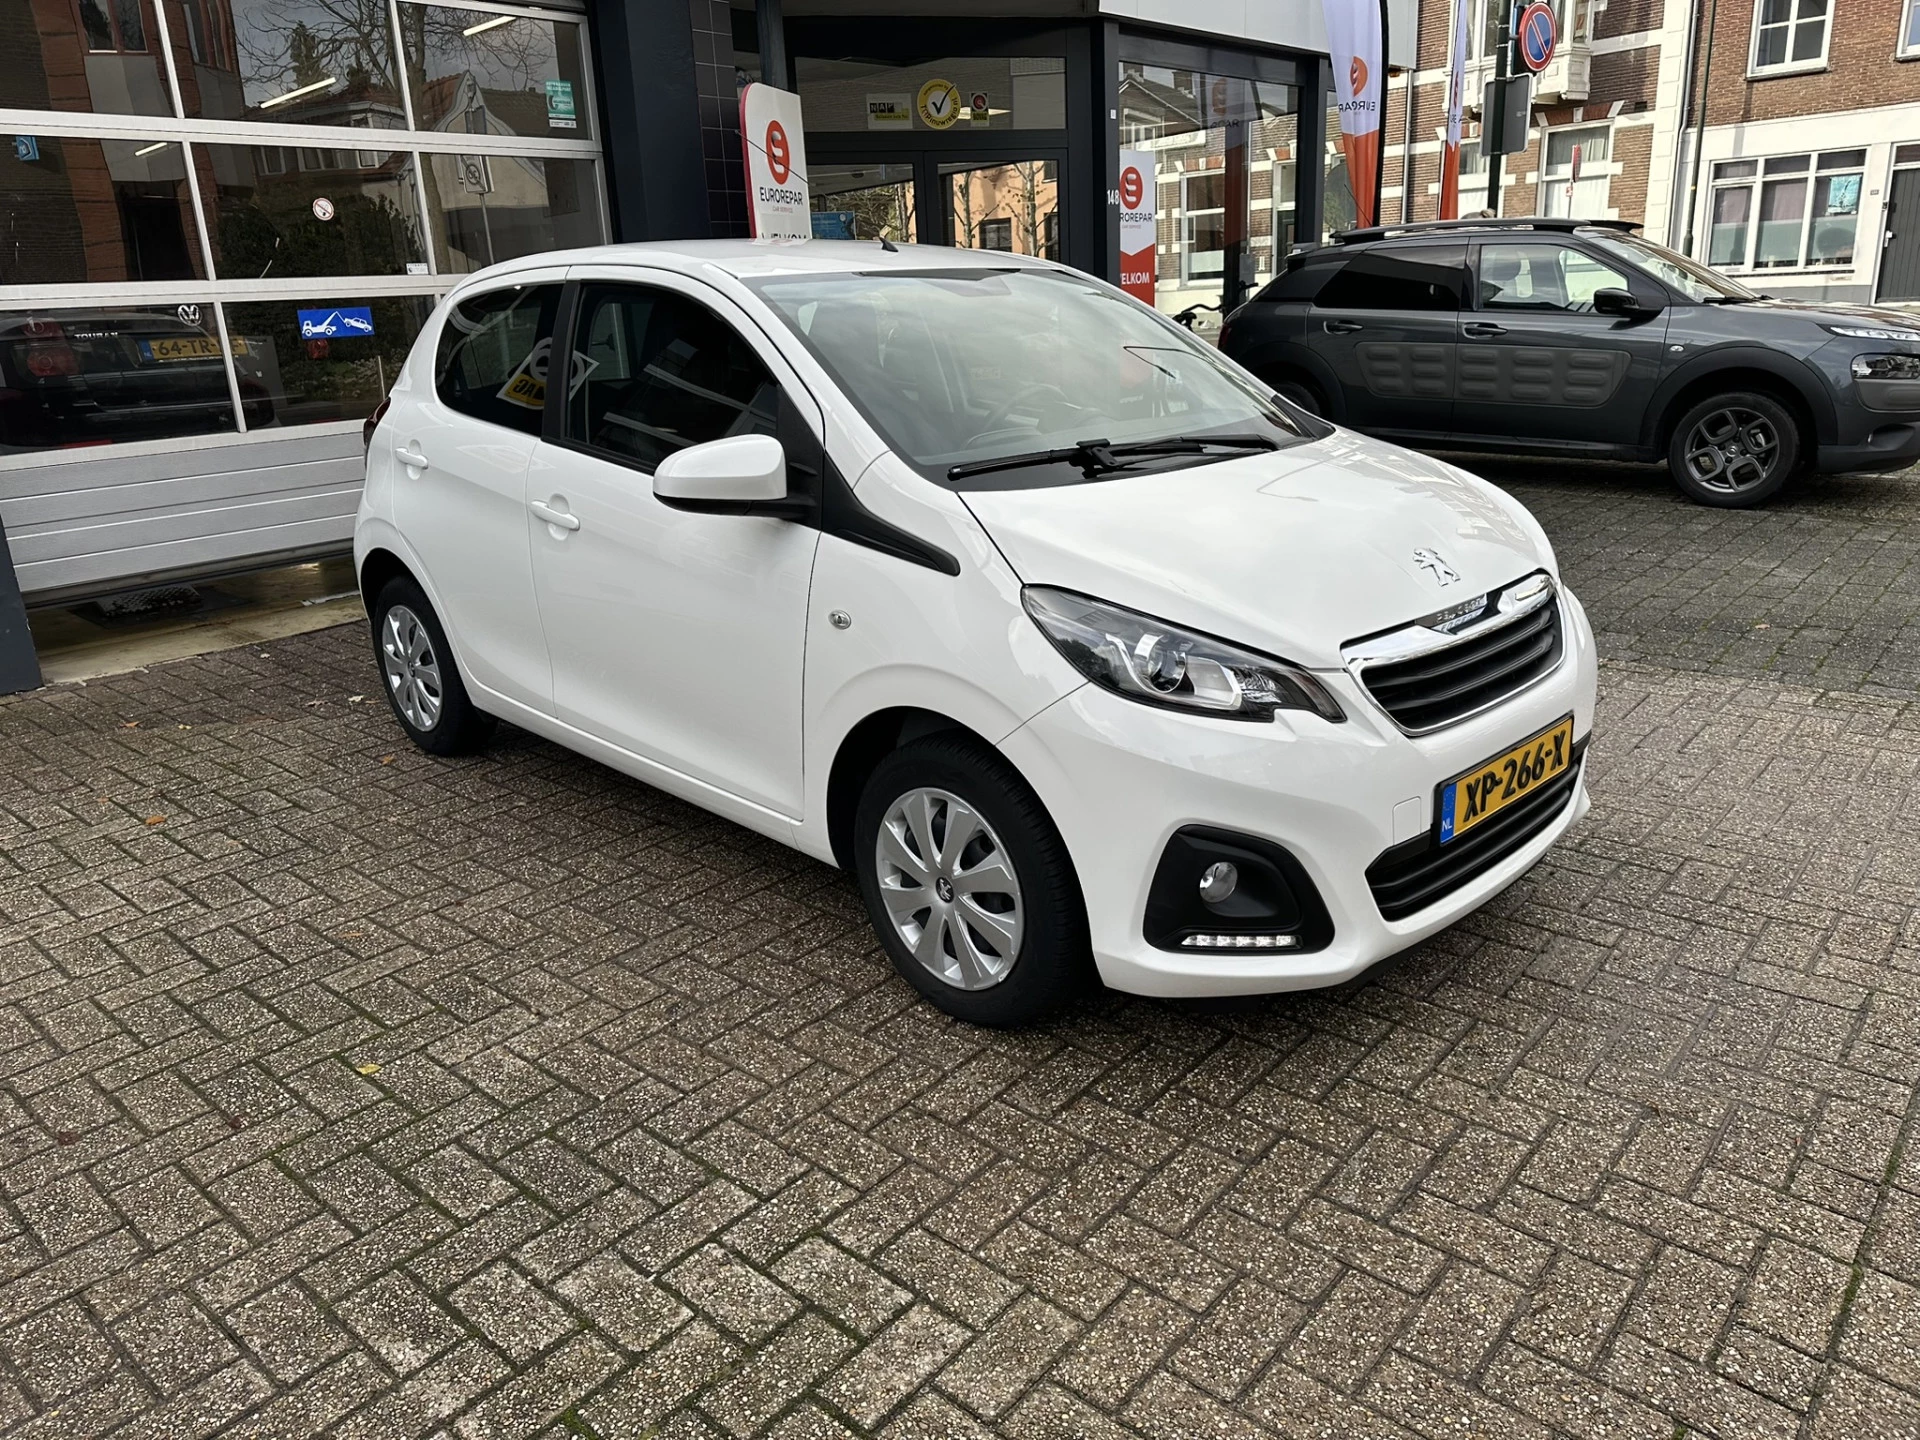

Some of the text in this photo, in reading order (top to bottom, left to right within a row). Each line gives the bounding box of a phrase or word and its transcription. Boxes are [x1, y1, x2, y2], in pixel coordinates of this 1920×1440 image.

[760, 186, 803, 205] EUROREPAR
[1107, 189, 1119, 205] 148
[1121, 272, 1150, 285] ELKOM
[158, 339, 239, 356] 64-TR-F
[1463, 729, 1566, 823] XP-266-X
[1441, 818, 1453, 832] NL
